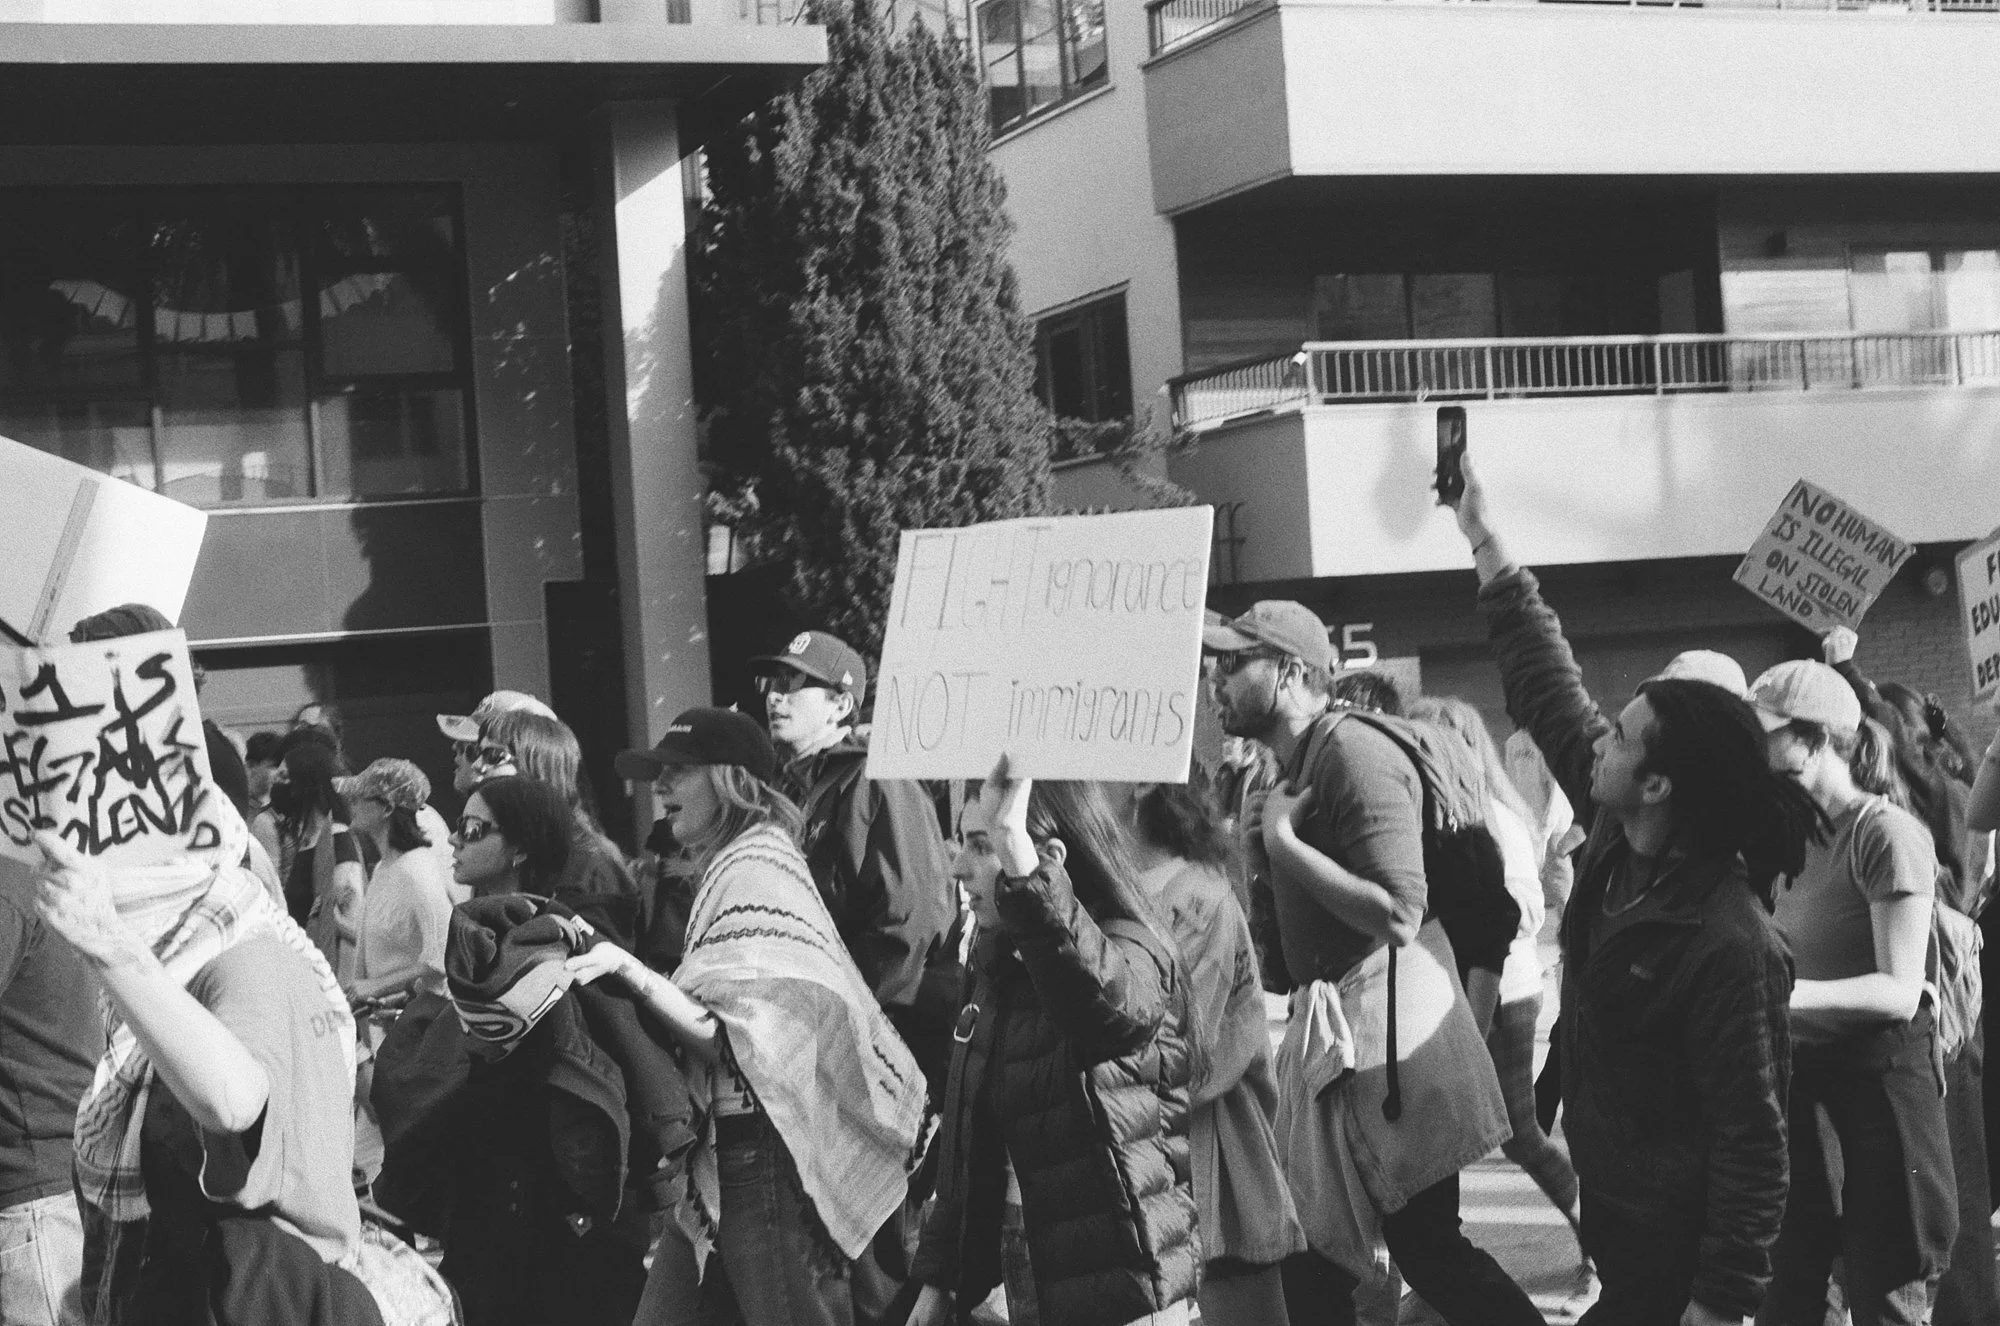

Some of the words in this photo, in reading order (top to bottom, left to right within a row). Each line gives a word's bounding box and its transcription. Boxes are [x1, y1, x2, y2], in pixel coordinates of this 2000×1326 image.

[1771, 512, 1802, 542] IS
[1797, 529, 1870, 592] ILLEGAL
[1790, 486, 1838, 525] NO
[1831, 510, 1907, 569] HUMAN
[1758, 574, 1814, 617] LAND
[1766, 549, 1799, 578] ON
[1796, 572, 1860, 618] STOLEN
[884, 670, 990, 753] NOT
